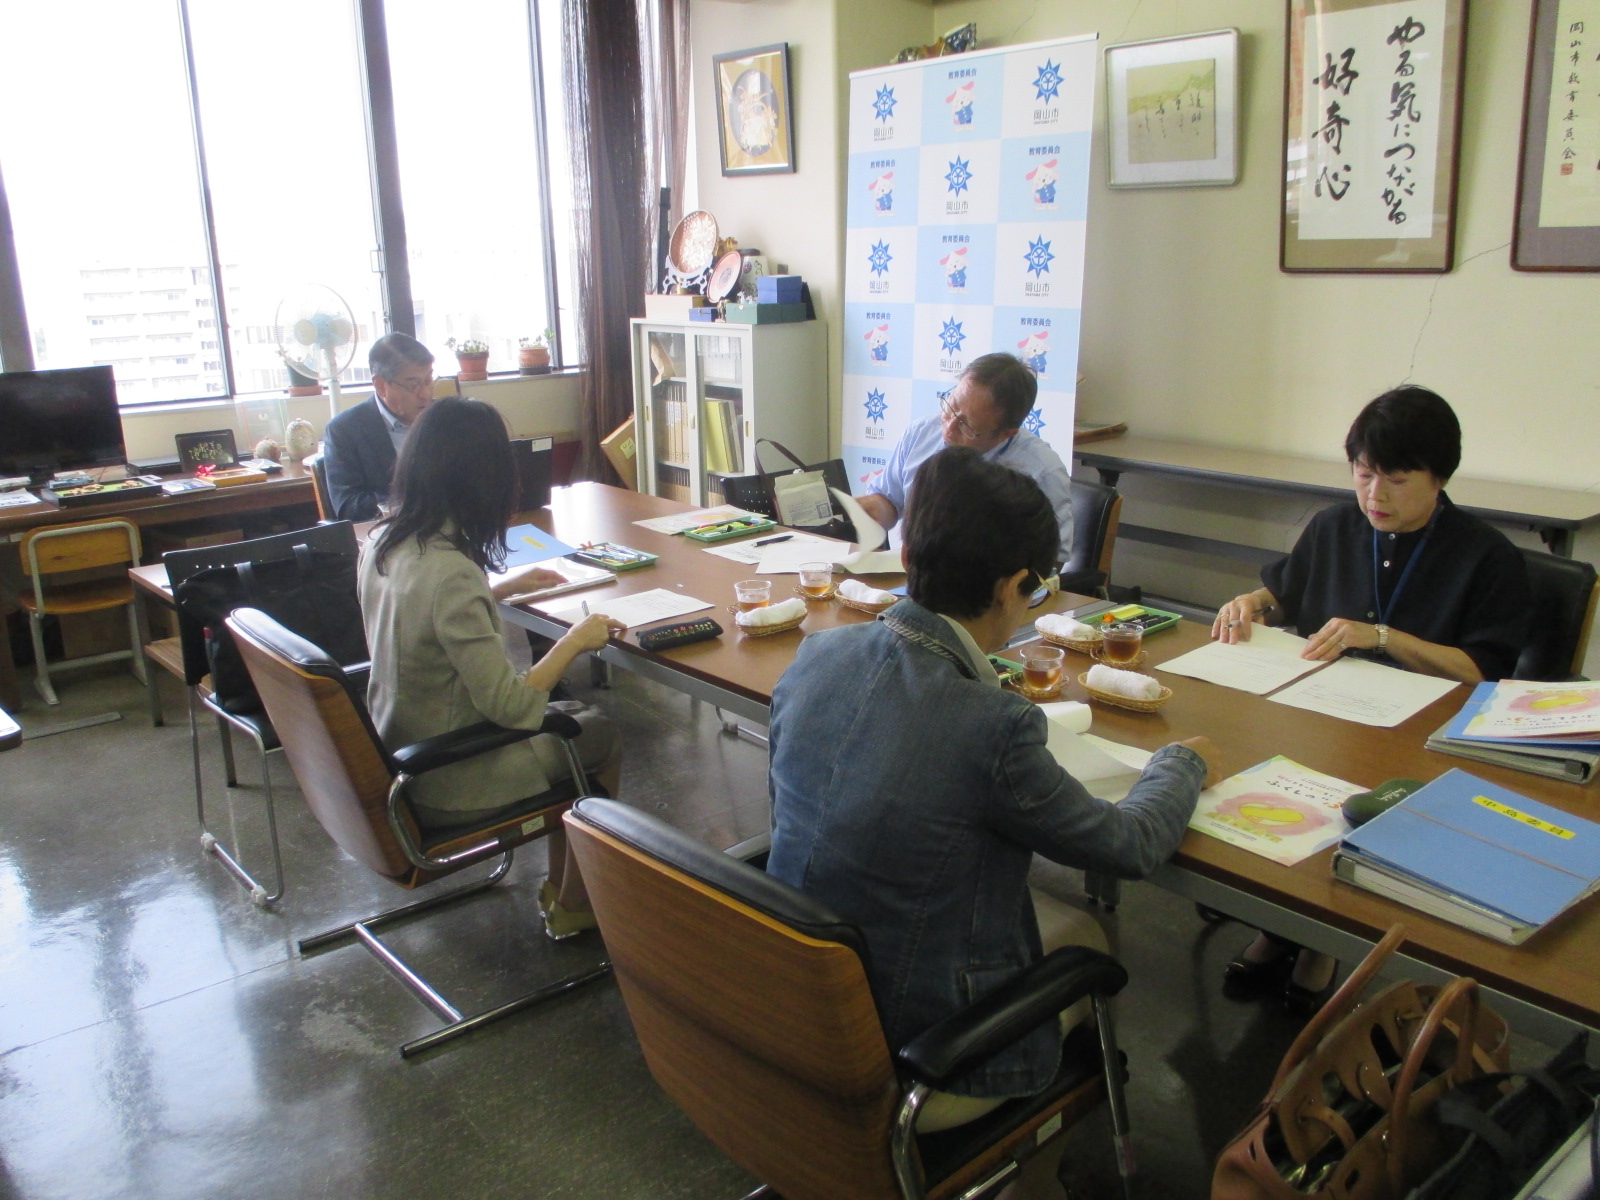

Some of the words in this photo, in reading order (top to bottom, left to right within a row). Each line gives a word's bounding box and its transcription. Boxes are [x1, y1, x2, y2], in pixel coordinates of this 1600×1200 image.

[948, 68, 977, 80] 教育委員会
[1561, 21, 1585, 160] 岡山市教育委員会
[1033, 108, 1059, 120] 岡山市
[1311, 47, 1359, 201] 好奇心
[873, 127, 894, 138] 岡山市
[1028, 145, 1061, 156] 教育委員会
[870, 159, 896, 169] 教育委員会
[945, 201, 969, 211] 岡山市
[942, 234, 970, 243] 教育委員会
[869, 281, 890, 290] 岡山市
[1025, 281, 1050, 293] 岡山市
[866, 312, 891, 320] 教育委員会
[1020, 317, 1051, 327] 教育委員会
[940, 359, 962, 370] 岡山市
[865, 426, 885, 437] 岡山市
[862, 456, 887, 466] 教育委員会
